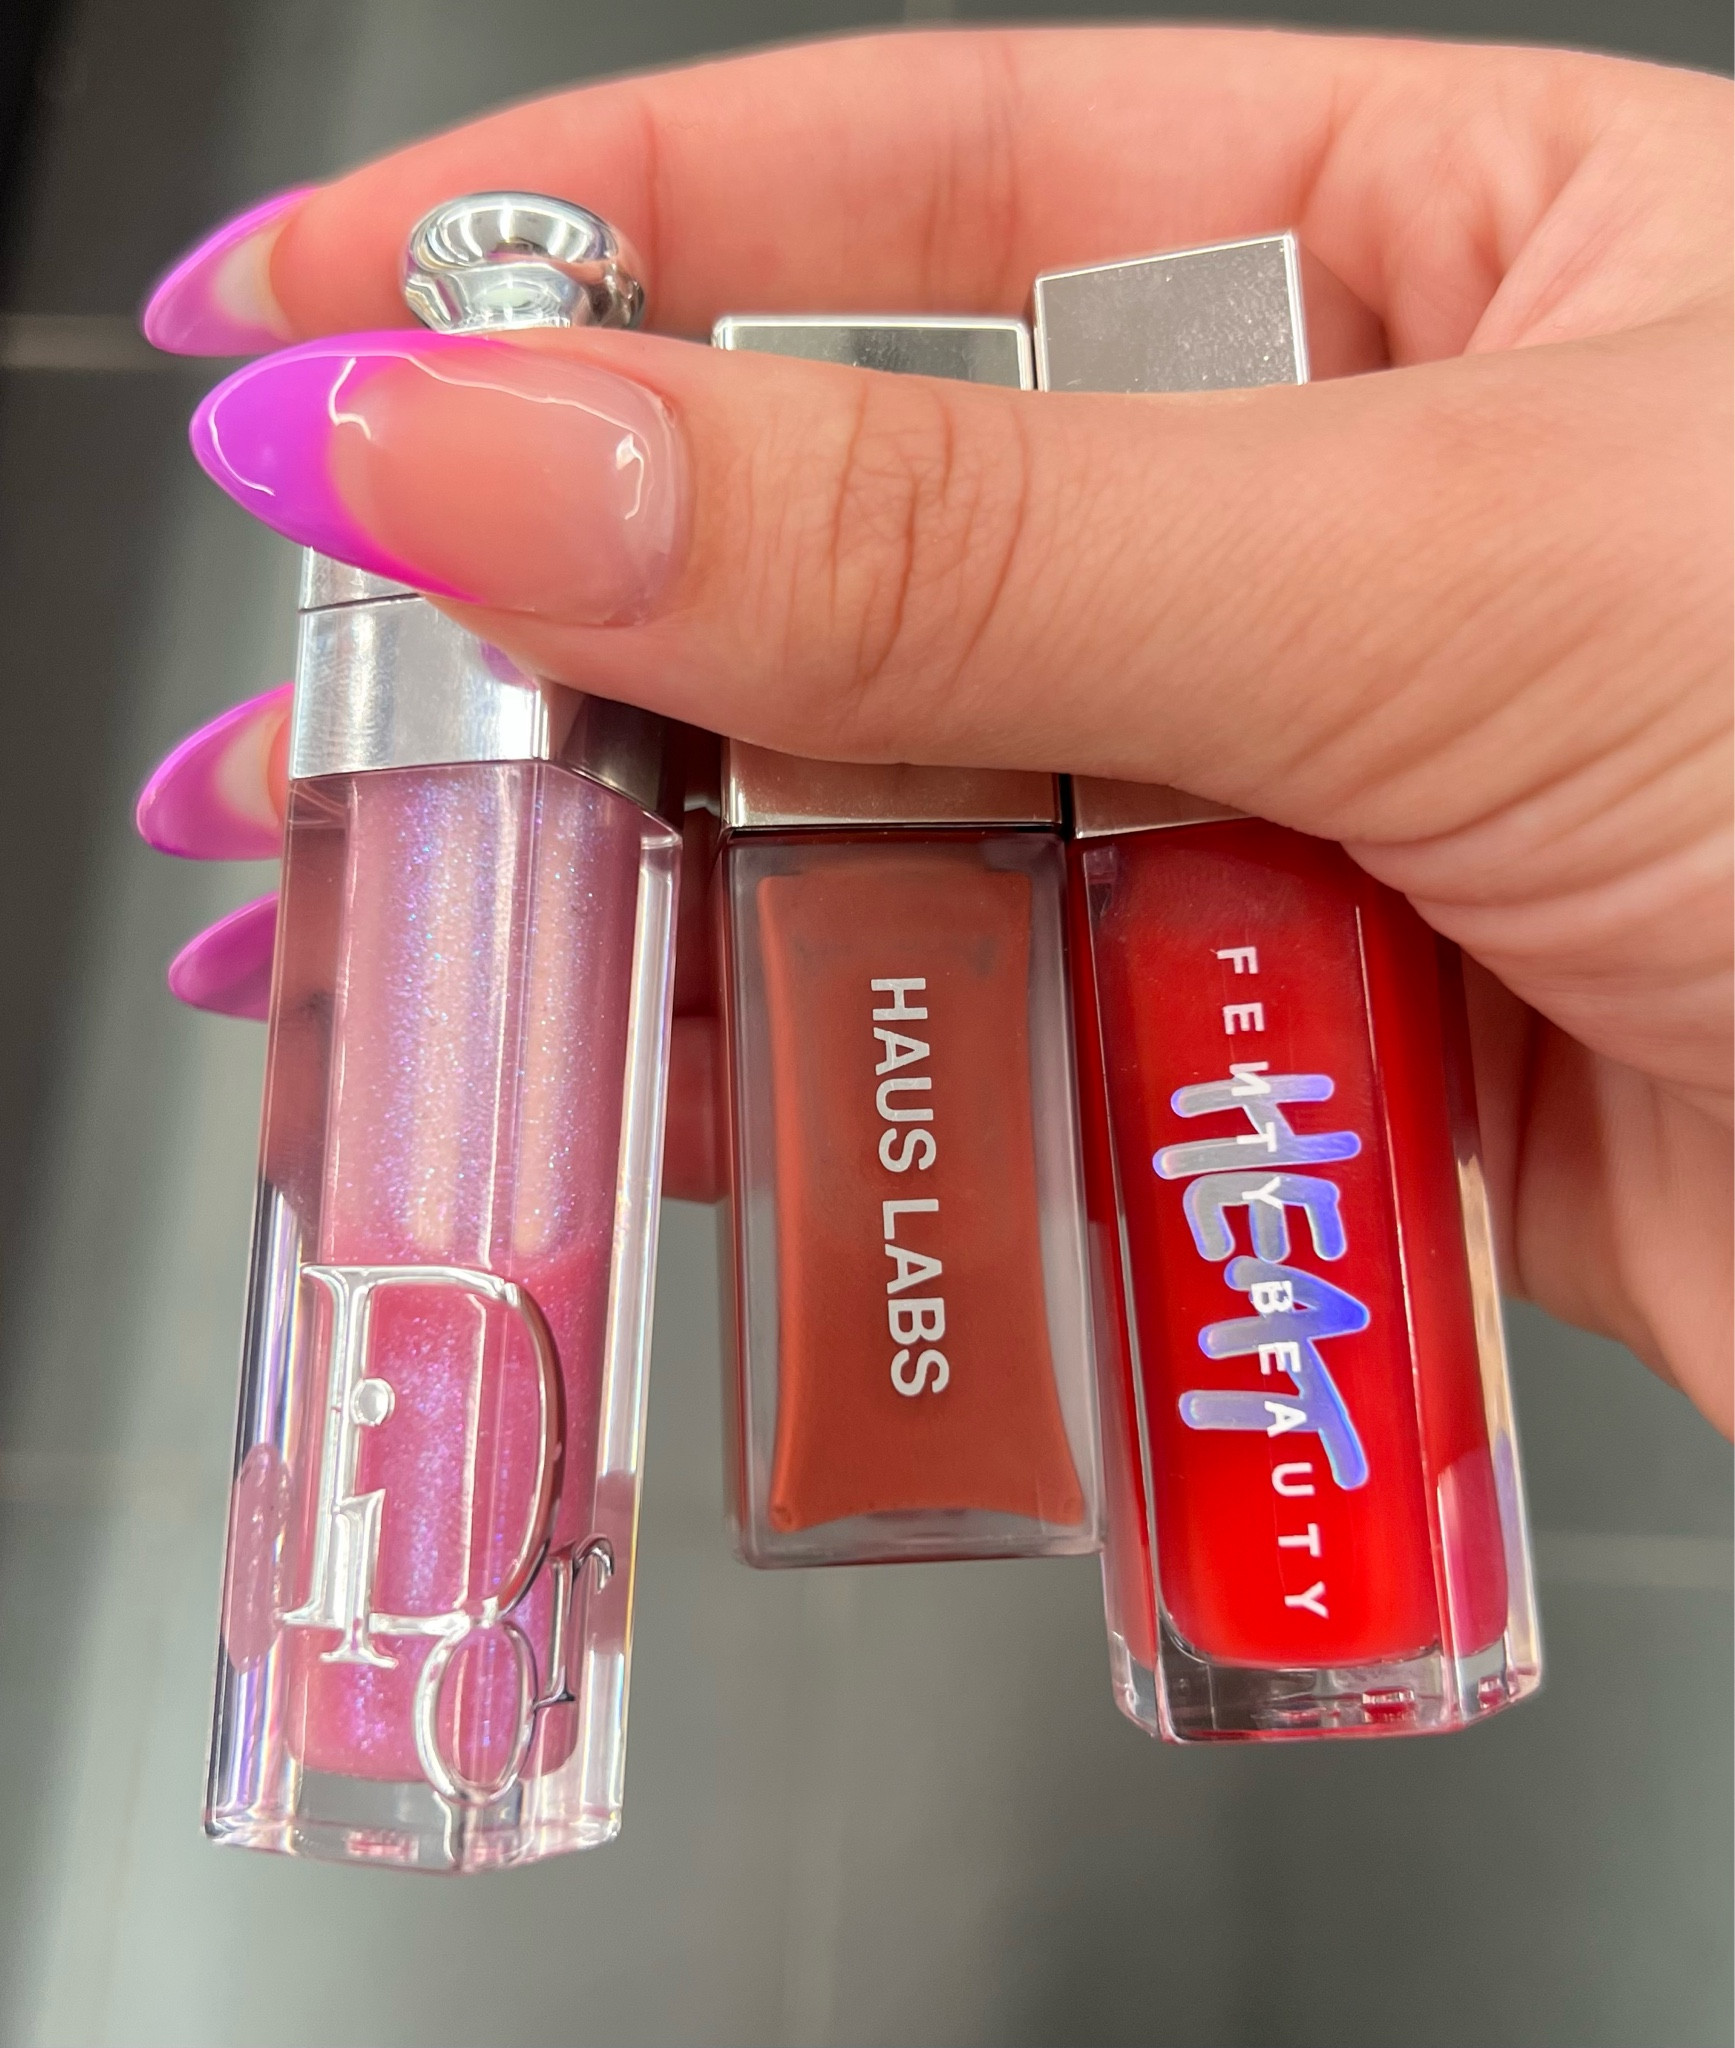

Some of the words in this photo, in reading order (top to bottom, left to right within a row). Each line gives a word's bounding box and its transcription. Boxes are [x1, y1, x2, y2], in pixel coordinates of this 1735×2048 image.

[870, 976, 937, 1174] HAUS
[881, 1198, 950, 1398] LABS
[1152, 1073, 1370, 1491] HEAT
[1249, 1280, 1329, 1620] BEAUTY
[276, 1262, 615, 1806] Dior
